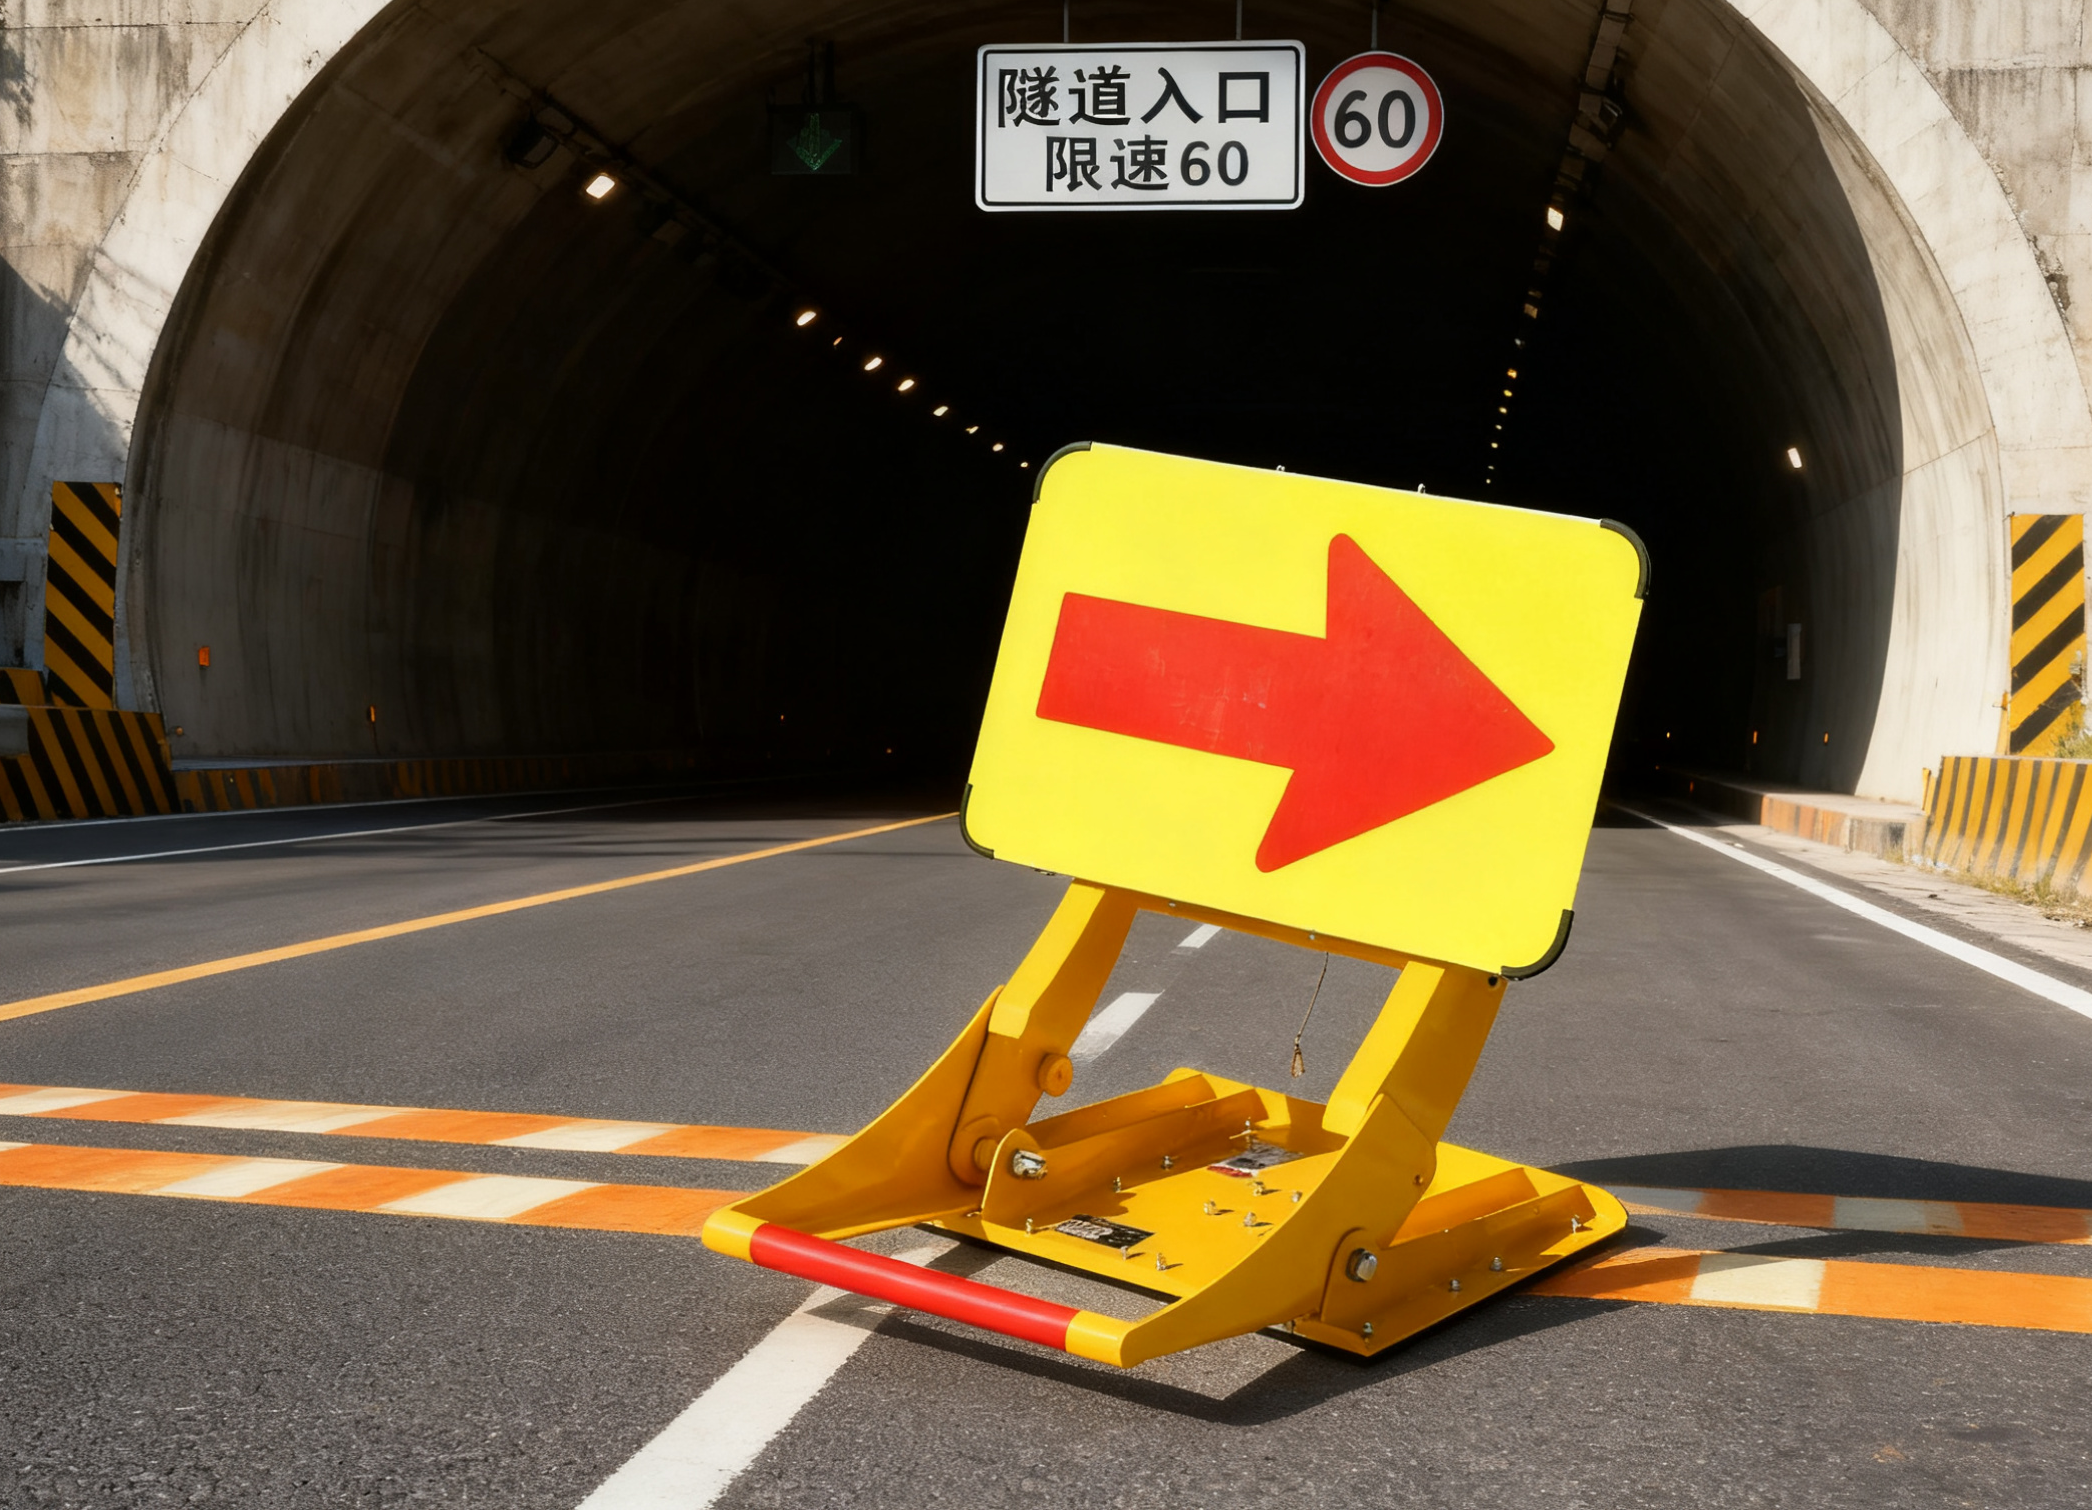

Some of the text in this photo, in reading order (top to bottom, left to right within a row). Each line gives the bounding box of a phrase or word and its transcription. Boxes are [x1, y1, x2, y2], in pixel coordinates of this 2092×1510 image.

[998, 64, 1270, 127] 隧道入口
[1334, 90, 1416, 148] 60
[1046, 134, 1249, 191] 限速60
